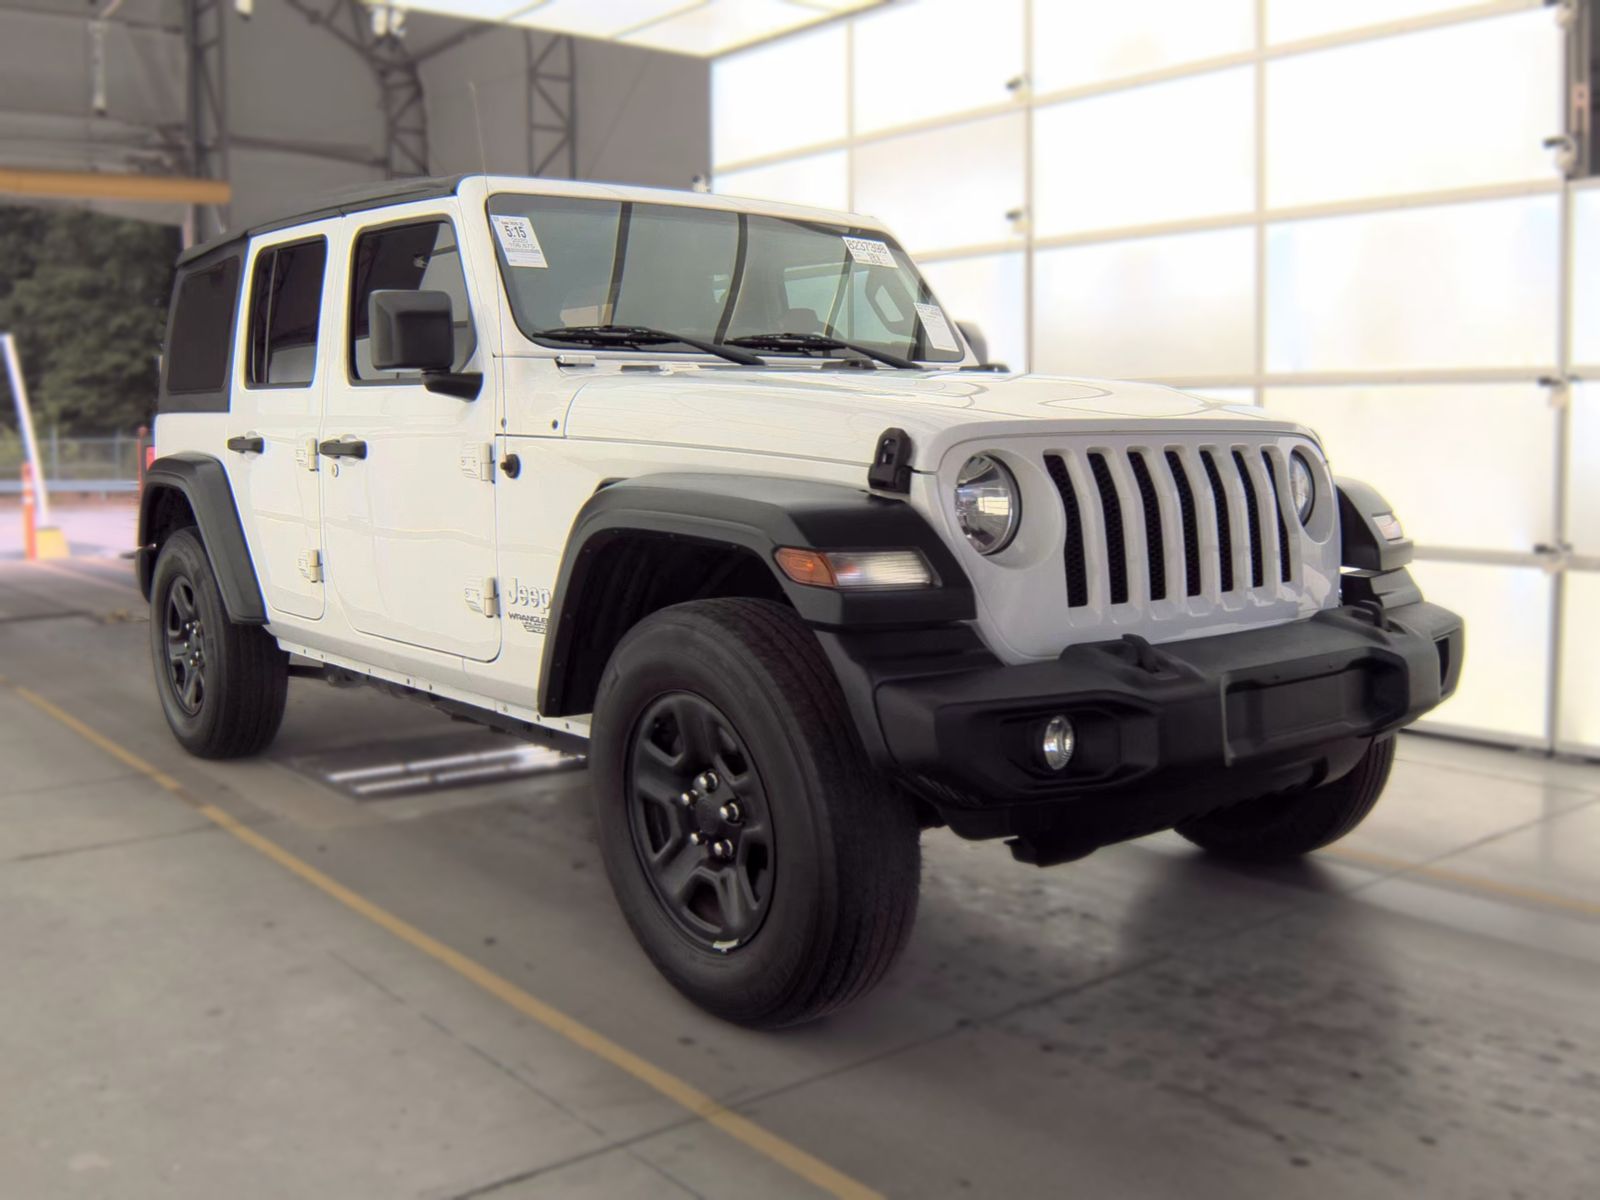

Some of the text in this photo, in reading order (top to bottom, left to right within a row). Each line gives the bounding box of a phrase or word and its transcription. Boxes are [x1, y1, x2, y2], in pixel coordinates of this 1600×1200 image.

[504, 225, 527, 239] 5:15
[508, 577, 551, 614] Jeep
[508, 611, 547, 624] WRANGLE
